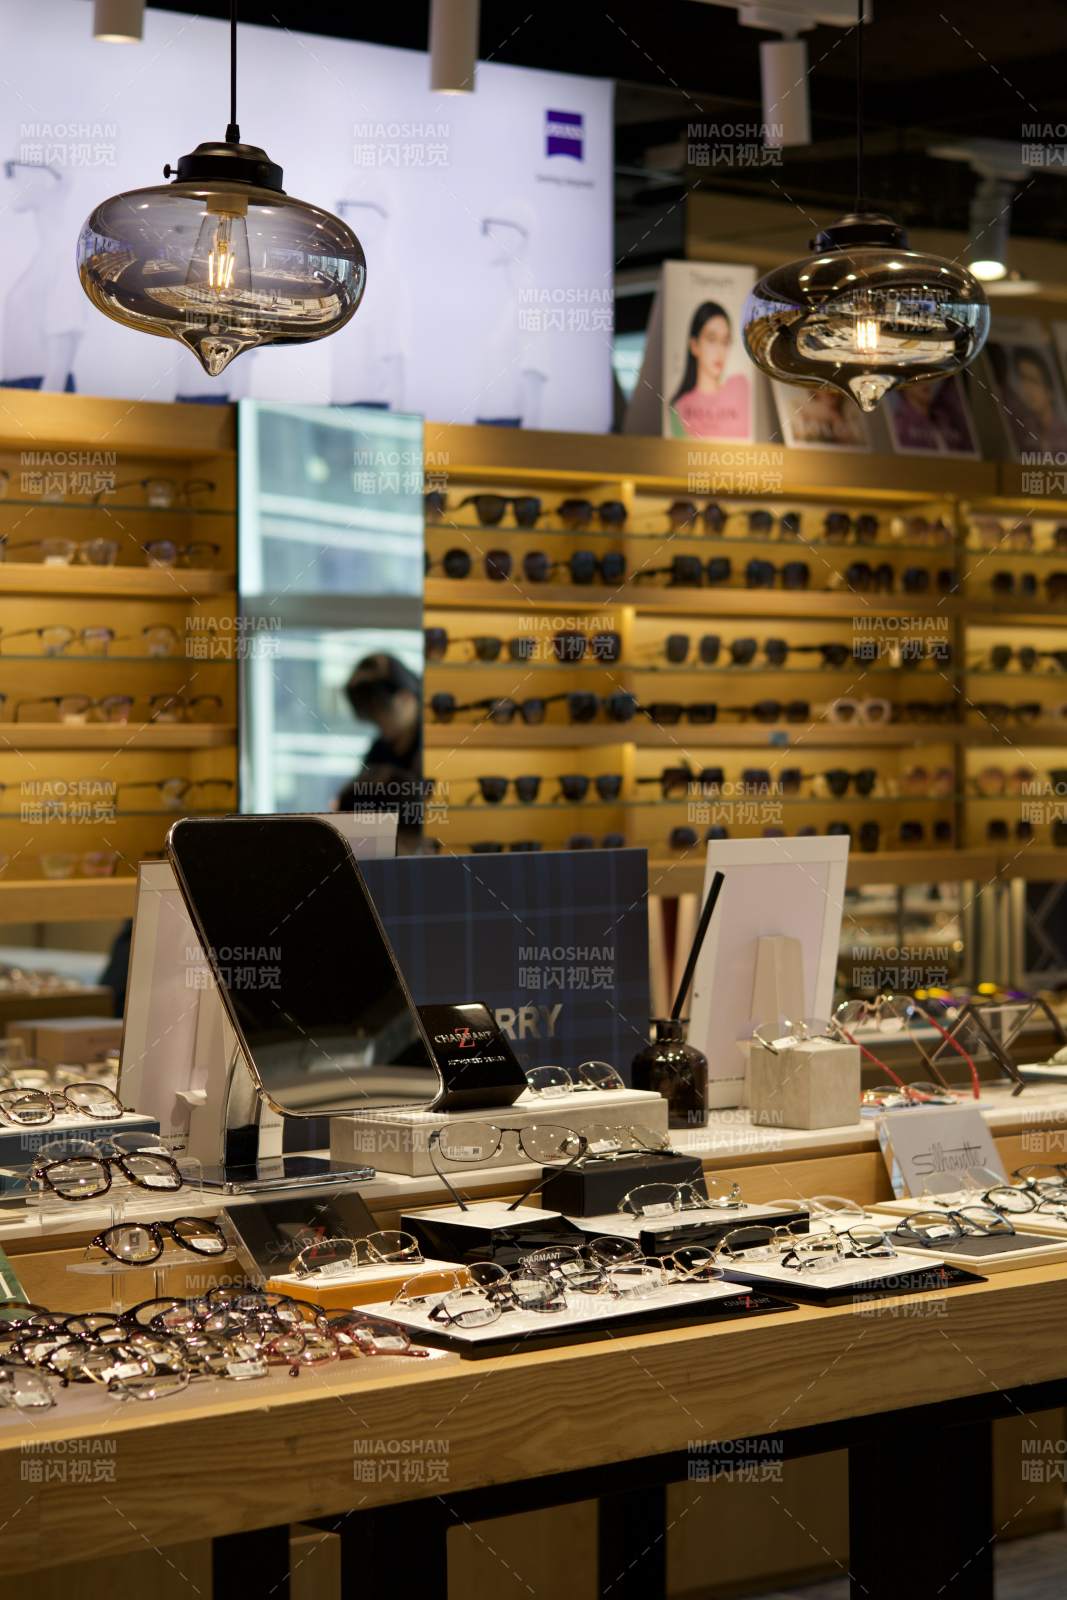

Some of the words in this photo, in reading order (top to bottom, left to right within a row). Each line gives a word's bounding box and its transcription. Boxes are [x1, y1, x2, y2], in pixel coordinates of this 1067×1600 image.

[491, 1003, 563, 1040] RRY
[434, 1031, 492, 1044] CHARMANT
[517, 1251, 561, 1264] CHARMANT
